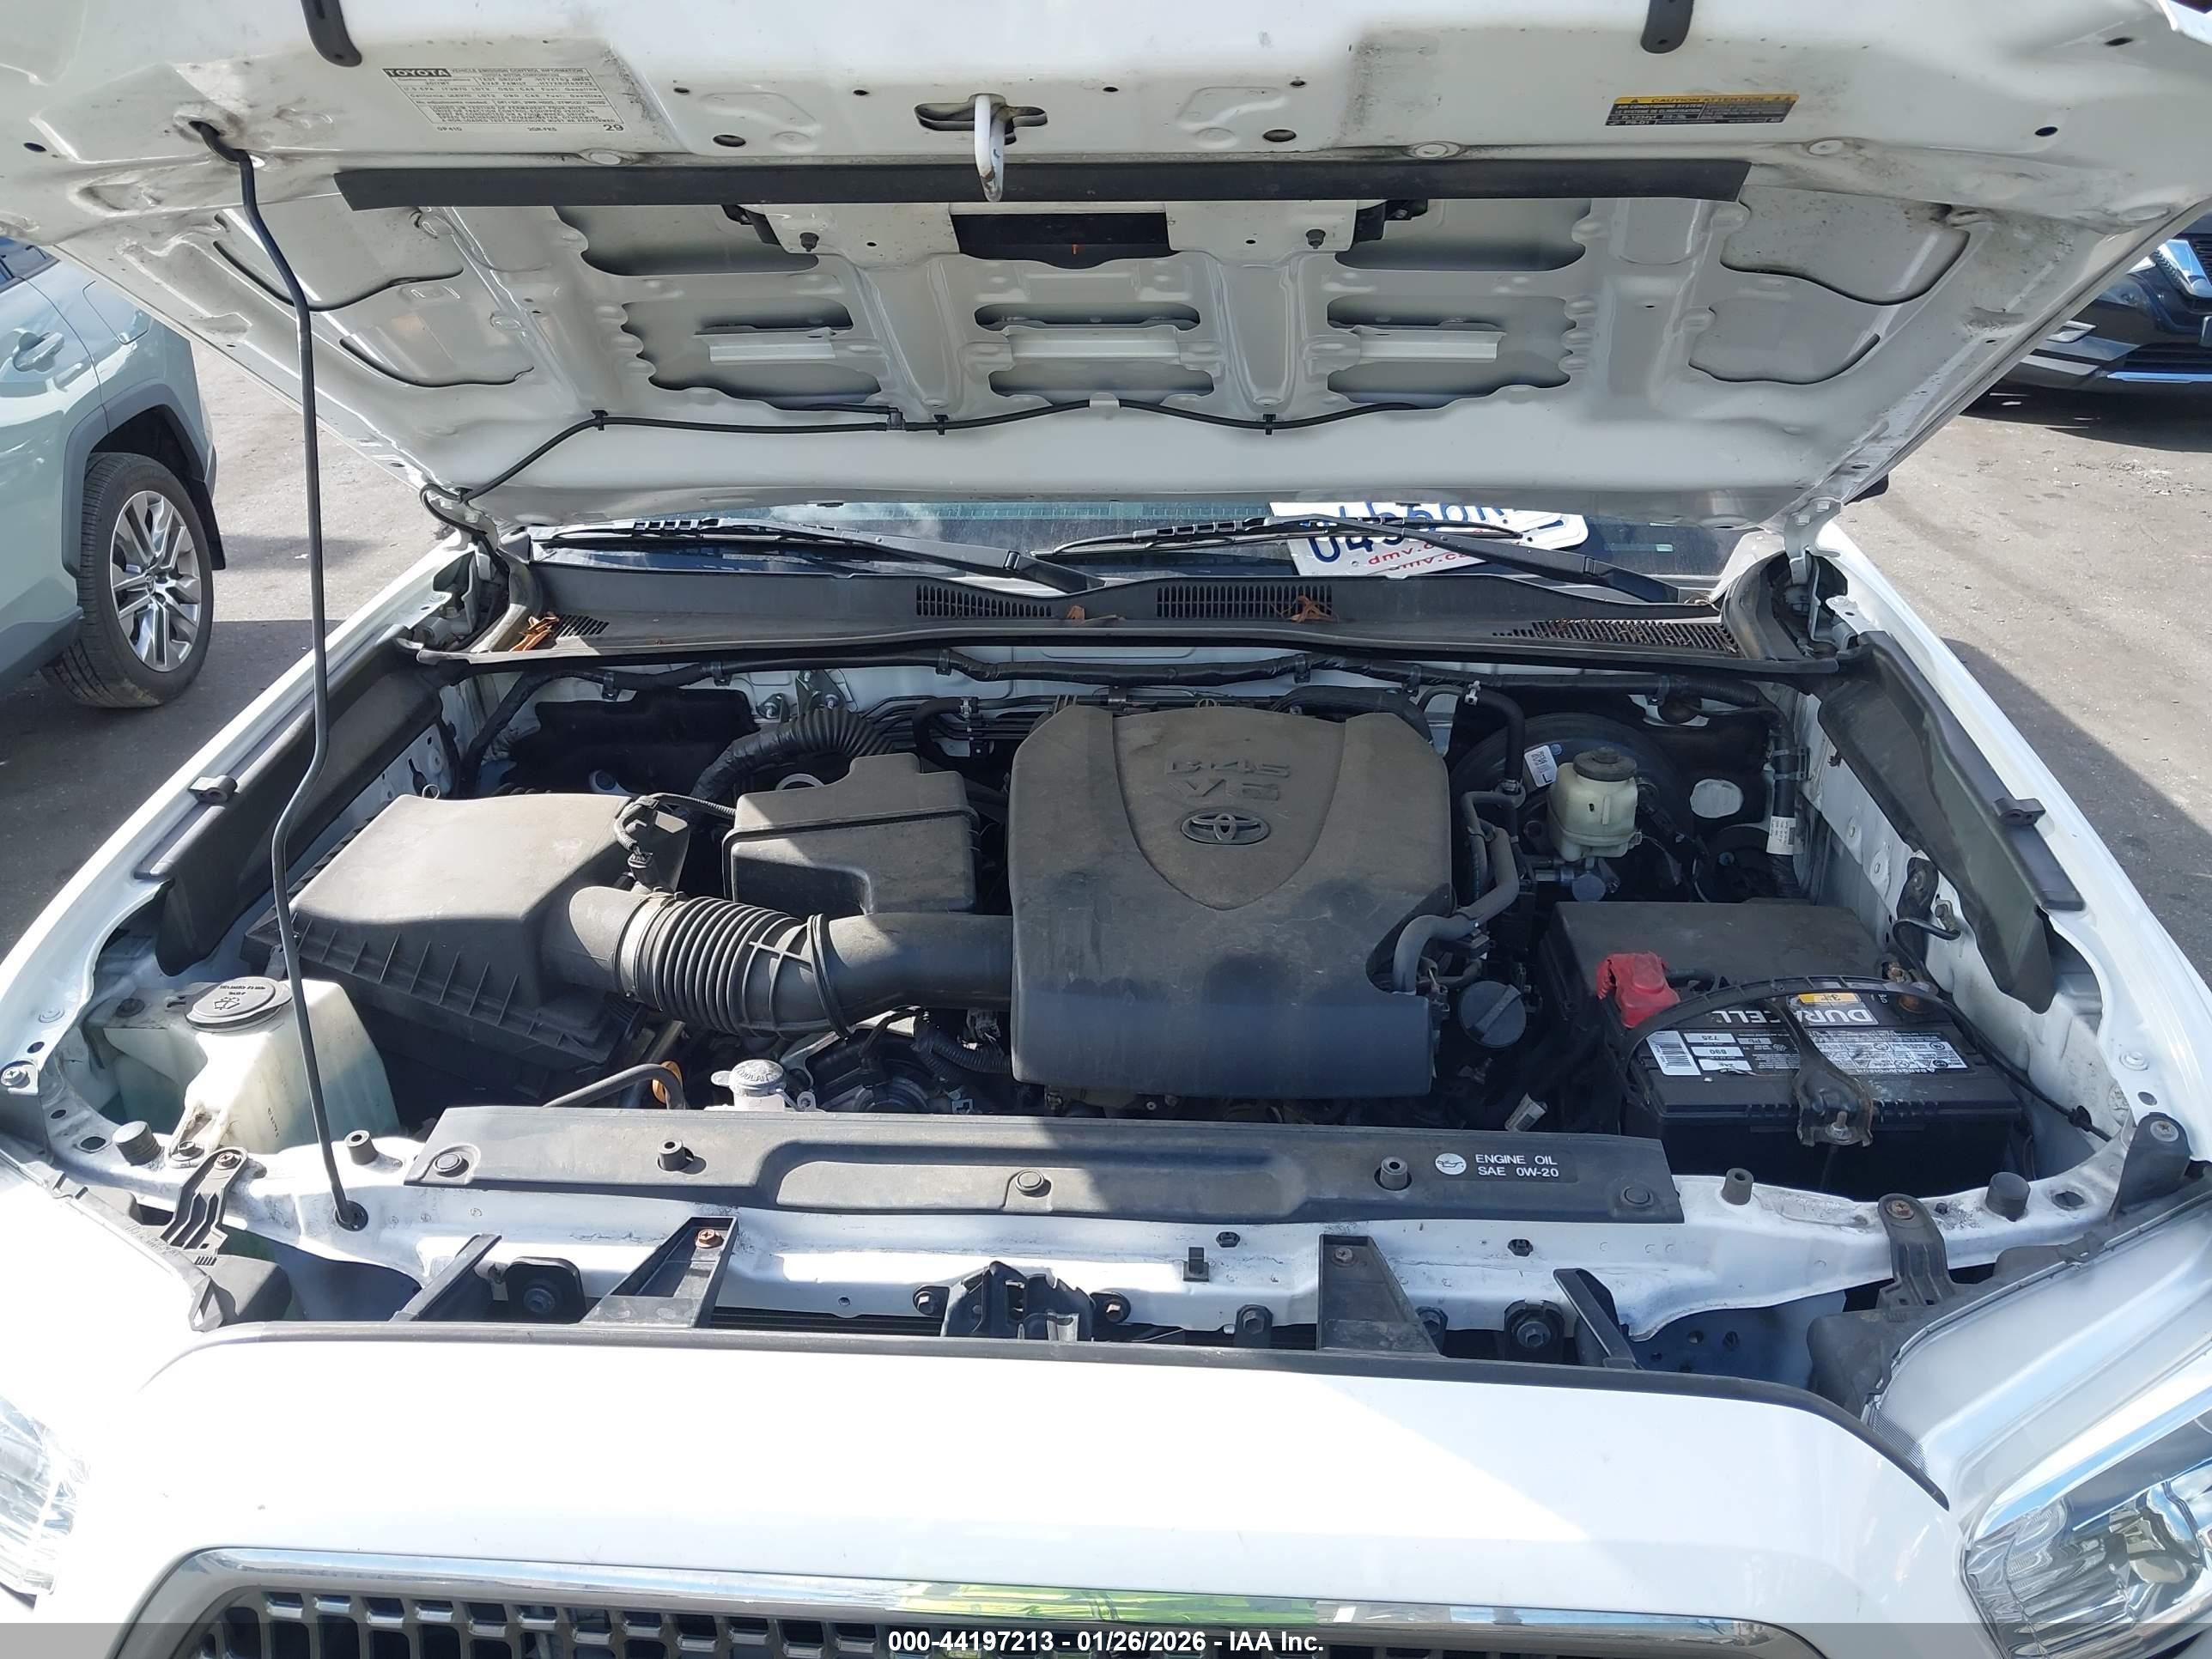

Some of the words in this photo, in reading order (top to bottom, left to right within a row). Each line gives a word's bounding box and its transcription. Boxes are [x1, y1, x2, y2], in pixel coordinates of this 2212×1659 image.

[1474, 1153, 1526, 1164] ENGINE
[1534, 1155, 1558, 1165] OIL
[1477, 1166, 1506, 1176] SAE
[1516, 1167, 1559, 1177] 0W-20
